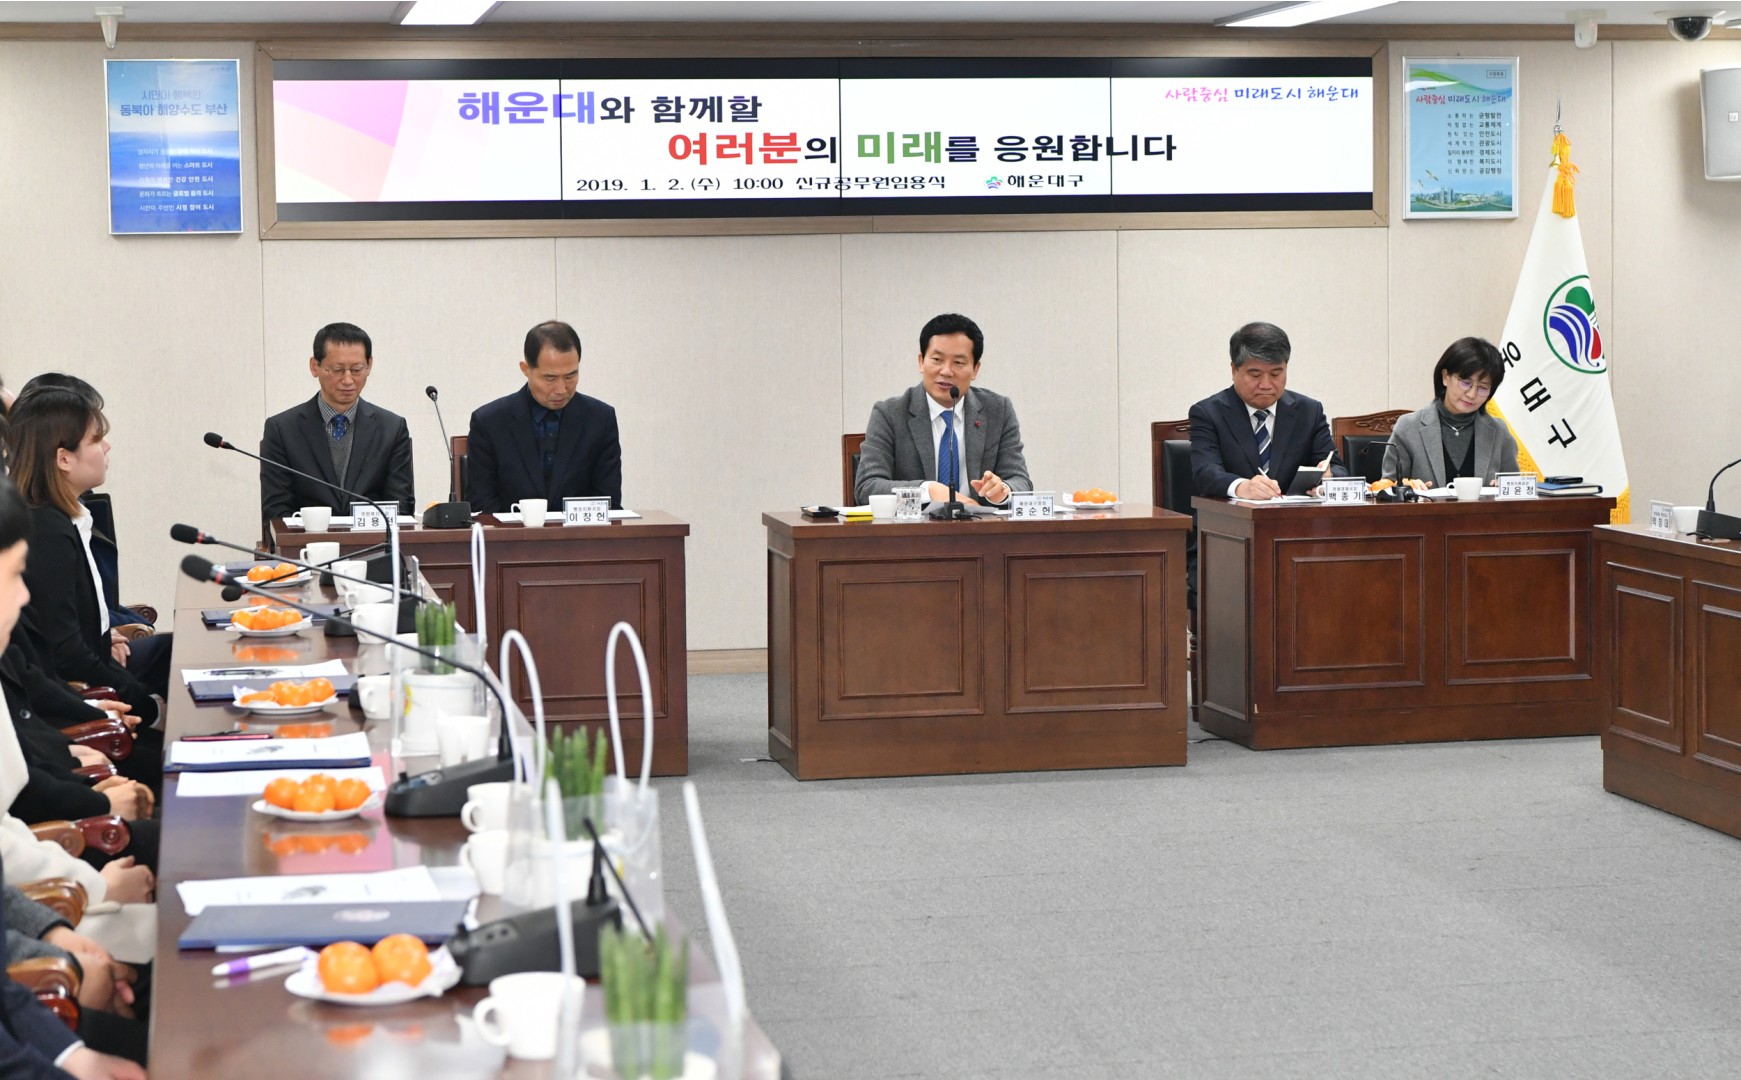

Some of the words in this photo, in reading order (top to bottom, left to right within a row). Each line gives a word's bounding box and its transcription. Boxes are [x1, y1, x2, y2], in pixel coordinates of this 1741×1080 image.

[1165, 86, 1228, 102] 사람중심
[1234, 86, 1302, 101] 미래도시
[1307, 85, 1359, 102] 해운대
[1416, 94, 1446, 105] 사람중심
[1447, 94, 1480, 104] 미래도시
[1482, 94, 1506, 105] 해운대
[120, 104, 154, 116] 동북아
[157, 103, 202, 116] 해양수도
[205, 103, 228, 116] 부산
[457, 91, 635, 125] 해운대와
[651, 95, 763, 124] 함께할
[668, 131, 838, 165] 여러분의
[857, 131, 981, 164] 미래를
[993, 133, 1178, 163] 응원합니다
[202, 161, 213, 169] 도시
[201, 175, 214, 183] 도시
[576, 177, 628, 191] 2019.
[640, 177, 656, 191] 1.
[733, 176, 784, 190] 10:00
[796, 175, 945, 192] 신규공무원임용식
[1007, 174, 1084, 191] 해운대구
[1502, 486, 1534, 496] 김윤정
[1016, 507, 1050, 516] 홍순헌
